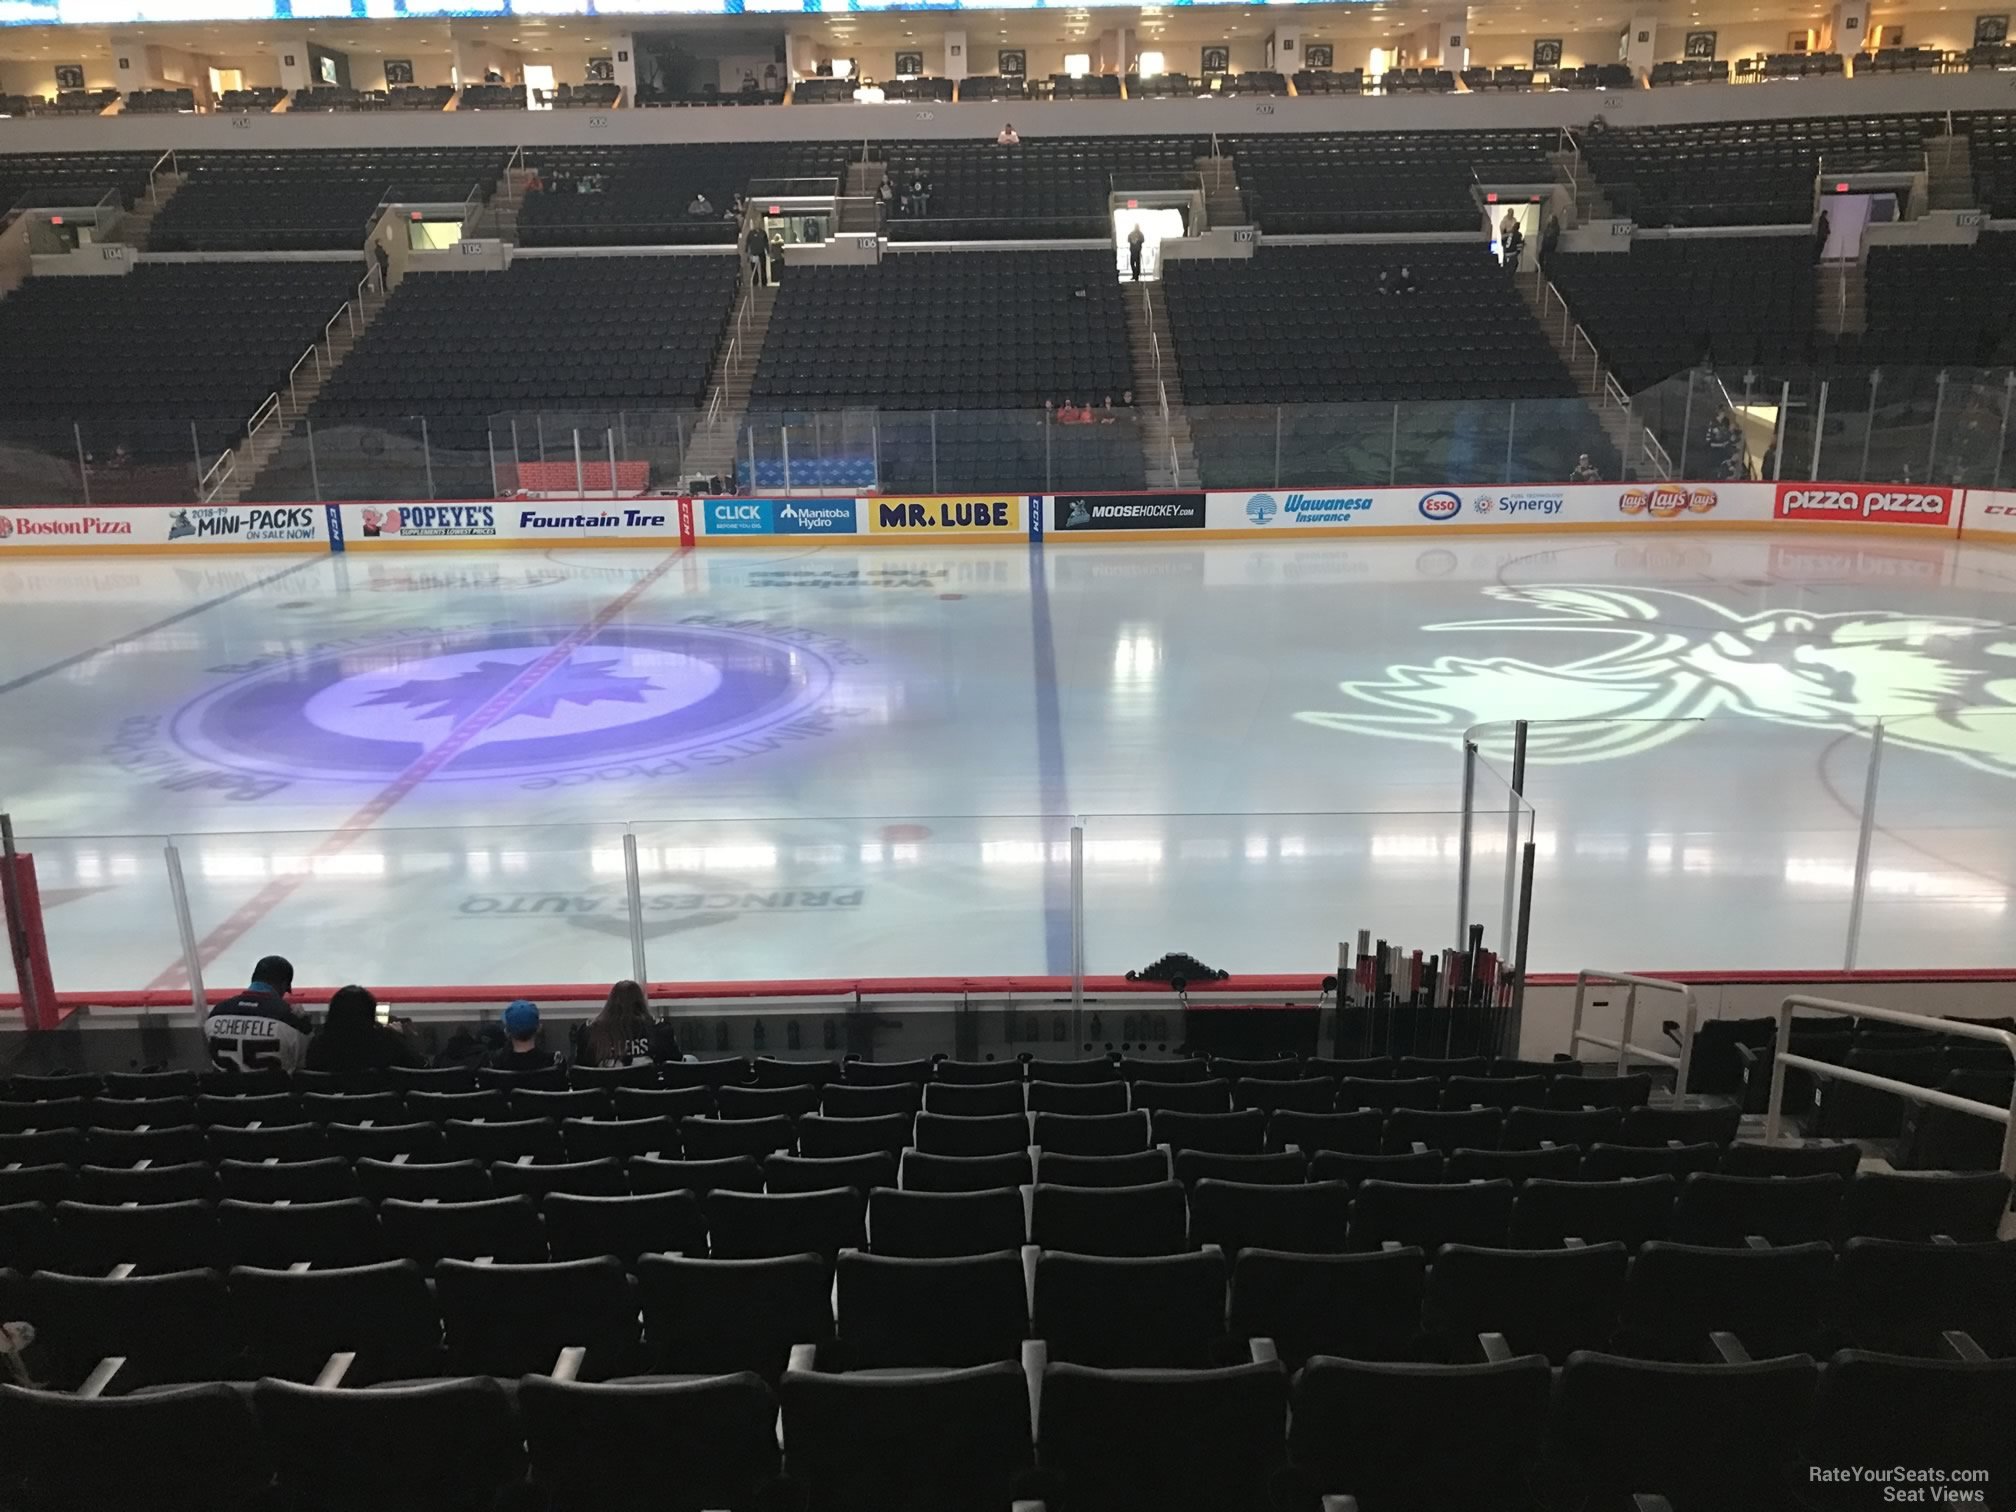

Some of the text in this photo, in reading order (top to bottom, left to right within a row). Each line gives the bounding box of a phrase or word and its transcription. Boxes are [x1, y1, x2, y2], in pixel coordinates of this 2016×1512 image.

[916, 112, 934, 120] 206
[858, 238, 876, 249] 106
[1234, 231, 1253, 241] 107
[103, 247, 122, 258] 104
[463, 244, 481, 255] 105
[715, 505, 761, 520] CLICK
[1284, 494, 1374, 513] Wawanesa
[1425, 499, 1456, 512] Esso
[1499, 496, 1564, 515] Synergy
[1783, 490, 1943, 517] pizza pizza
[192, 507, 228, 519] 2018-19
[398, 505, 494, 528] POPEYE'S
[520, 510, 665, 528] Fountain Tire
[681, 502, 692, 536] CCM
[799, 507, 850, 519] Manitoba
[940, 502, 1008, 527] LUBE
[1032, 499, 1040, 533] CCM
[1295, 511, 1352, 523] Insurance
[16, 516, 132, 535] Boston Pizza
[198, 508, 313, 537] MINI-PACKS
[329, 507, 341, 541] CCM
[799, 517, 832, 530] Hydro
[247, 526, 315, 540] ON SALE NOW!
[459, 895, 600, 913] AUTO
[213, 1019, 277, 1037] SCHEIFELE
[207, 1036, 282, 1072] 55
